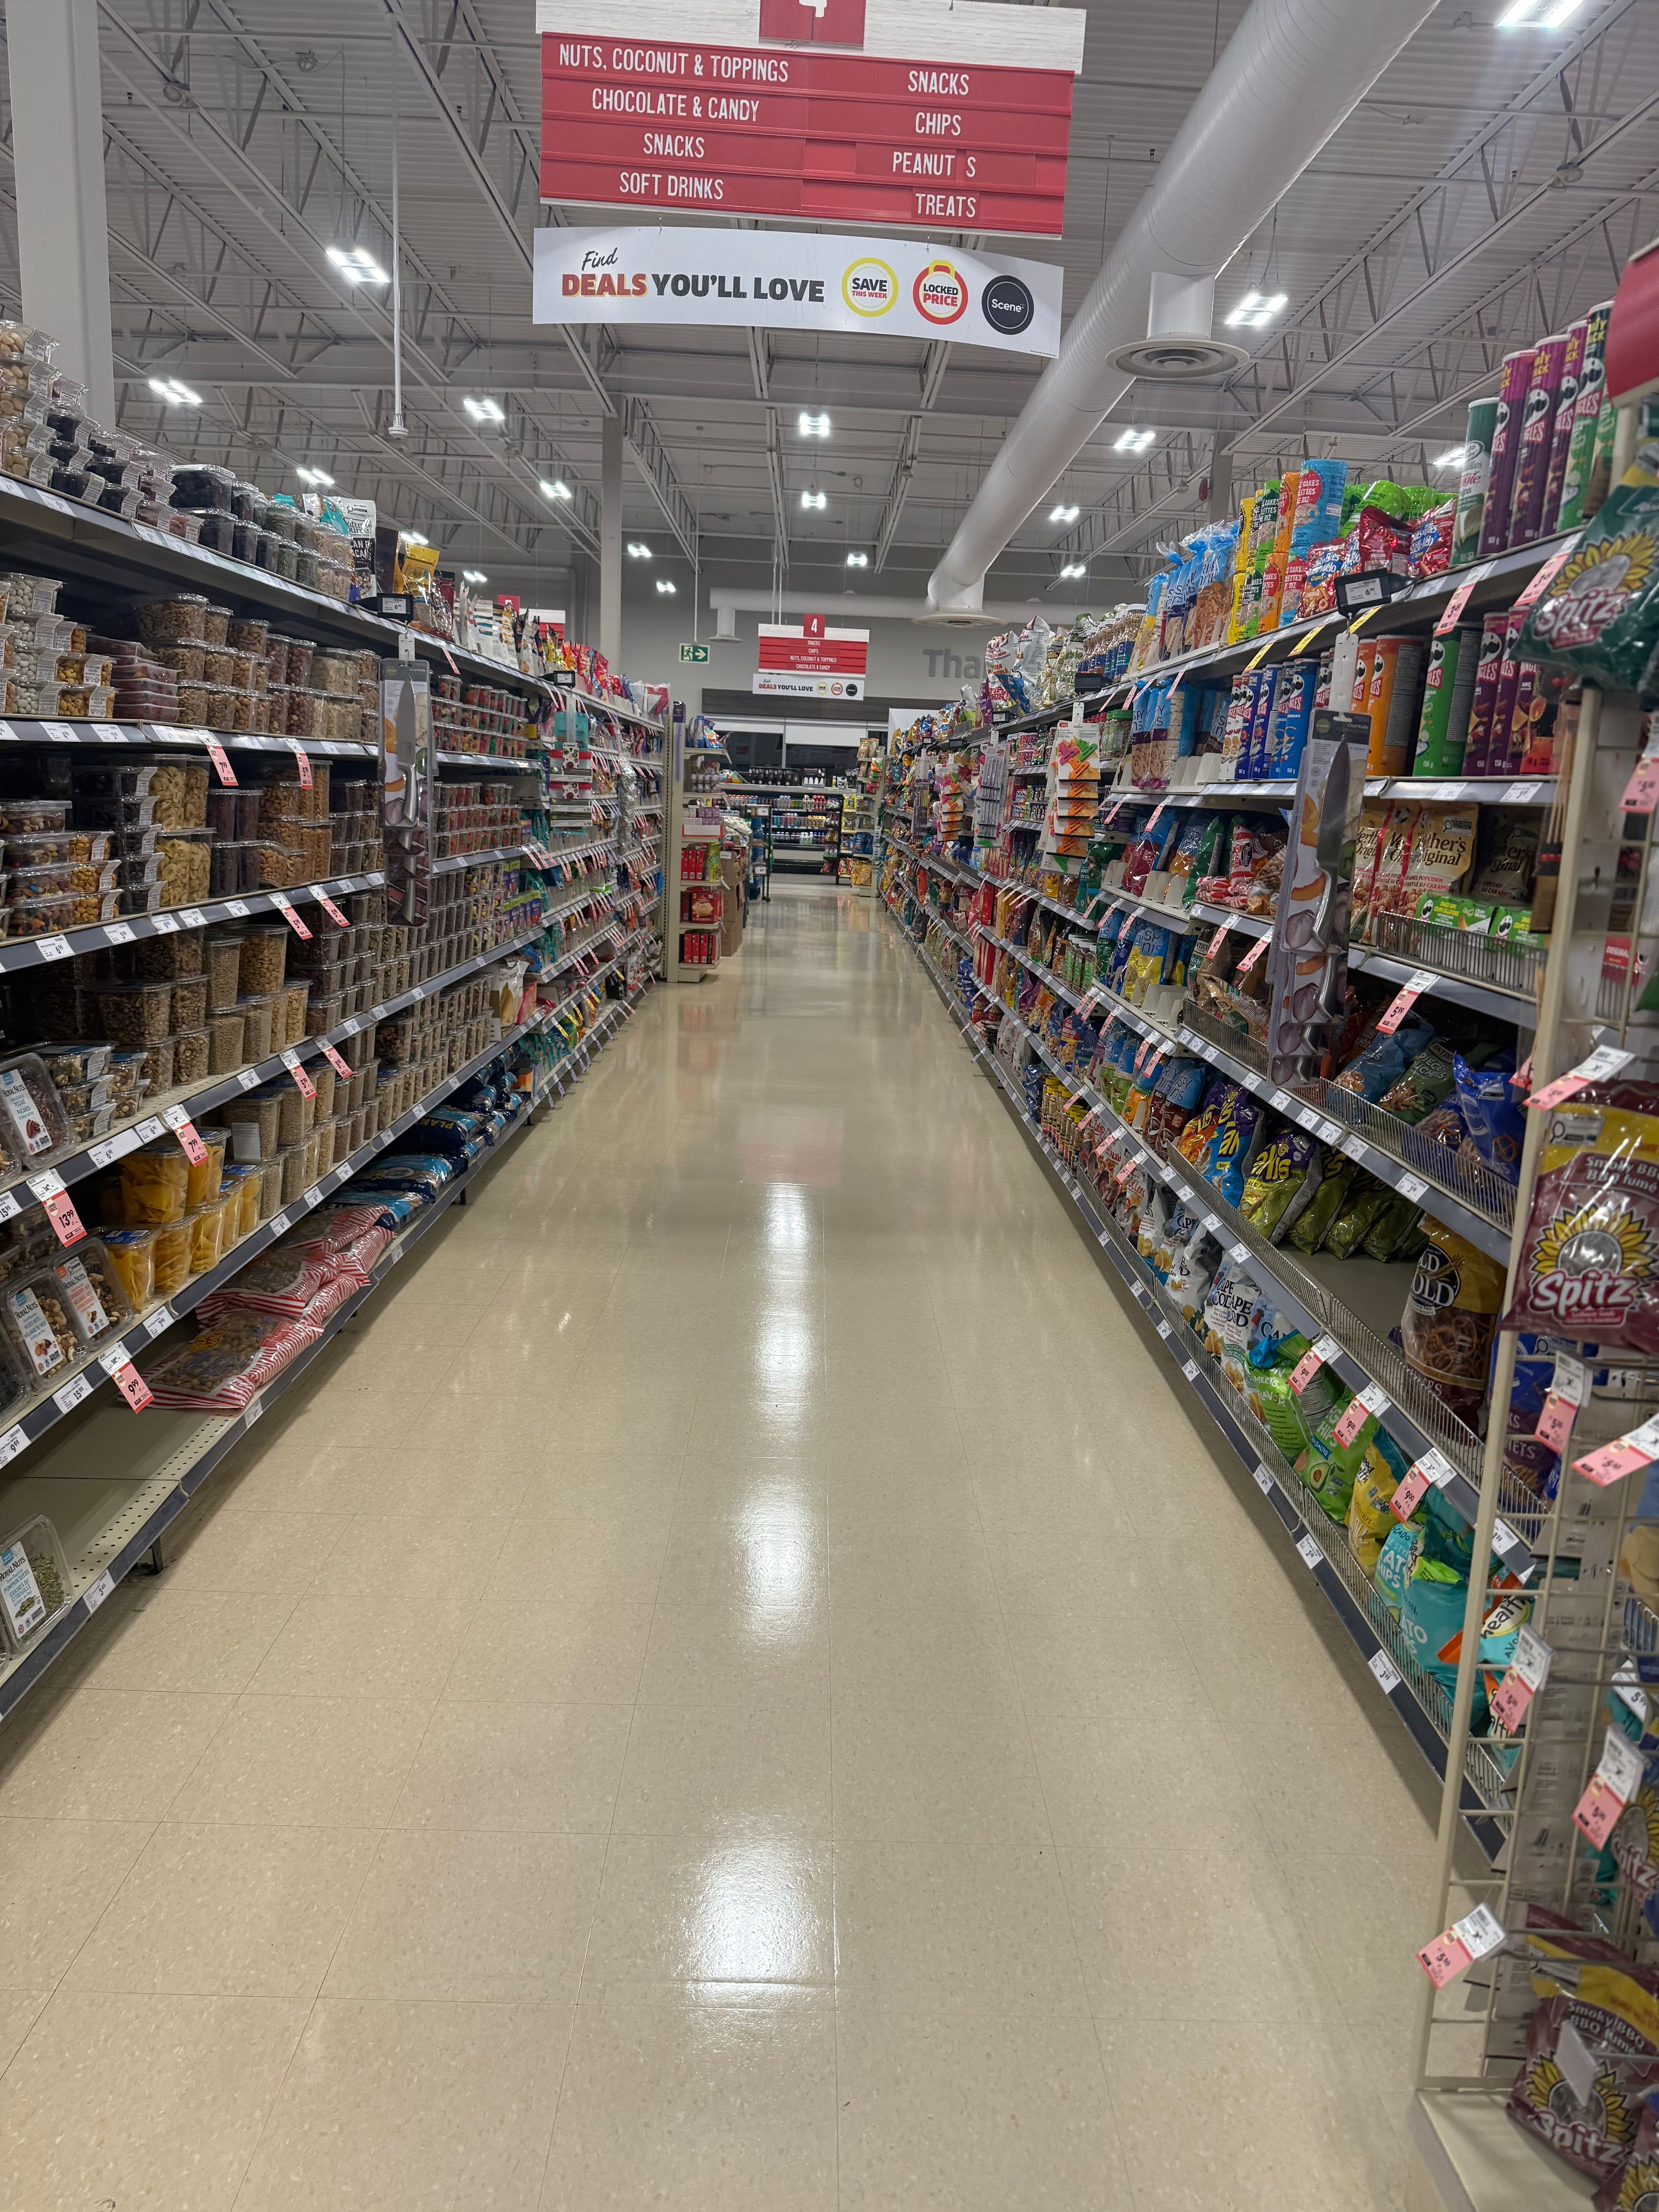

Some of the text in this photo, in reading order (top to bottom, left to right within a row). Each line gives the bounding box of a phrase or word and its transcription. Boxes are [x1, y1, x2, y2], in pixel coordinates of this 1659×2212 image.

[560, 44, 789, 82] NUTS, COCONUT & TOPPINGS
[907, 70, 969, 96] SNACKS
[592, 88, 759, 121] CHOCOLATE & CANDY
[915, 112, 962, 135] CHIPS
[643, 133, 705, 158] SNACKS
[893, 152, 977, 178] PEANUT S
[619, 172, 724, 200] SOFT DRINKS
[915, 194, 977, 217] TREATS
[581, 248, 618, 271] Find
[562, 273, 824, 302] DEALS YOU'LL LOVE
[852, 277, 888, 292] SAVE
[868, 291, 888, 299] WEEK
[923, 283, 958, 295] LOCKED
[923, 293, 958, 307] PRICE
[811, 618, 818, 633] 4
[923, 648, 987, 679] Tha
[1586, 1156, 1632, 1174] Smoky
[1230, 1294, 1254, 1315] APE
[1533, 1271, 1636, 1316] Spitz
[1254, 1375, 1279, 1387] MEETS
[1568, 2001, 1646, 2048] Smoky BBQ
[1535, 2110, 1626, 2163] Spitz
